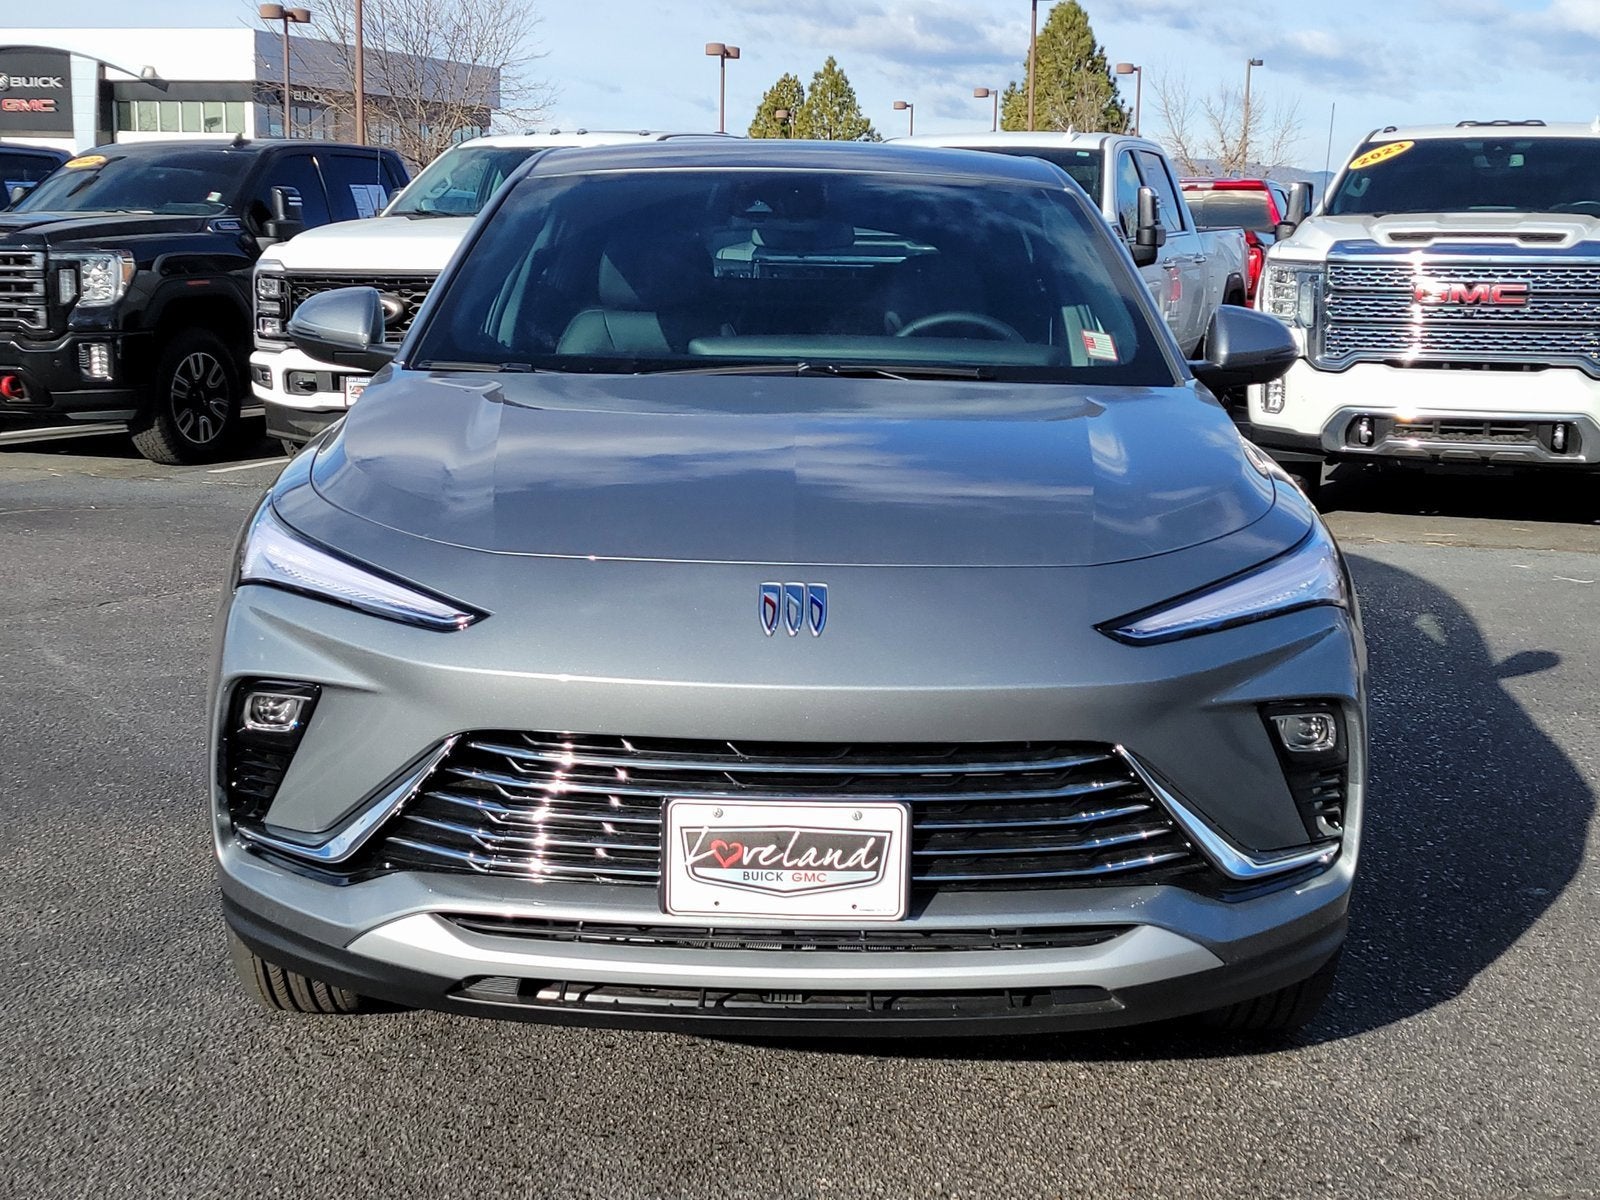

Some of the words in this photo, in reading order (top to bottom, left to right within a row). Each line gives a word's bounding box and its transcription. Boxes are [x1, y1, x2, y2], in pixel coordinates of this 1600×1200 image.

[10, 76, 63, 88] BUICK
[2, 98, 56, 112] GMC
[1359, 144, 1405, 165] 2023
[1413, 282, 1528, 304] GMC
[742, 871, 784, 882] BUICK
[791, 872, 827, 883] GMC
